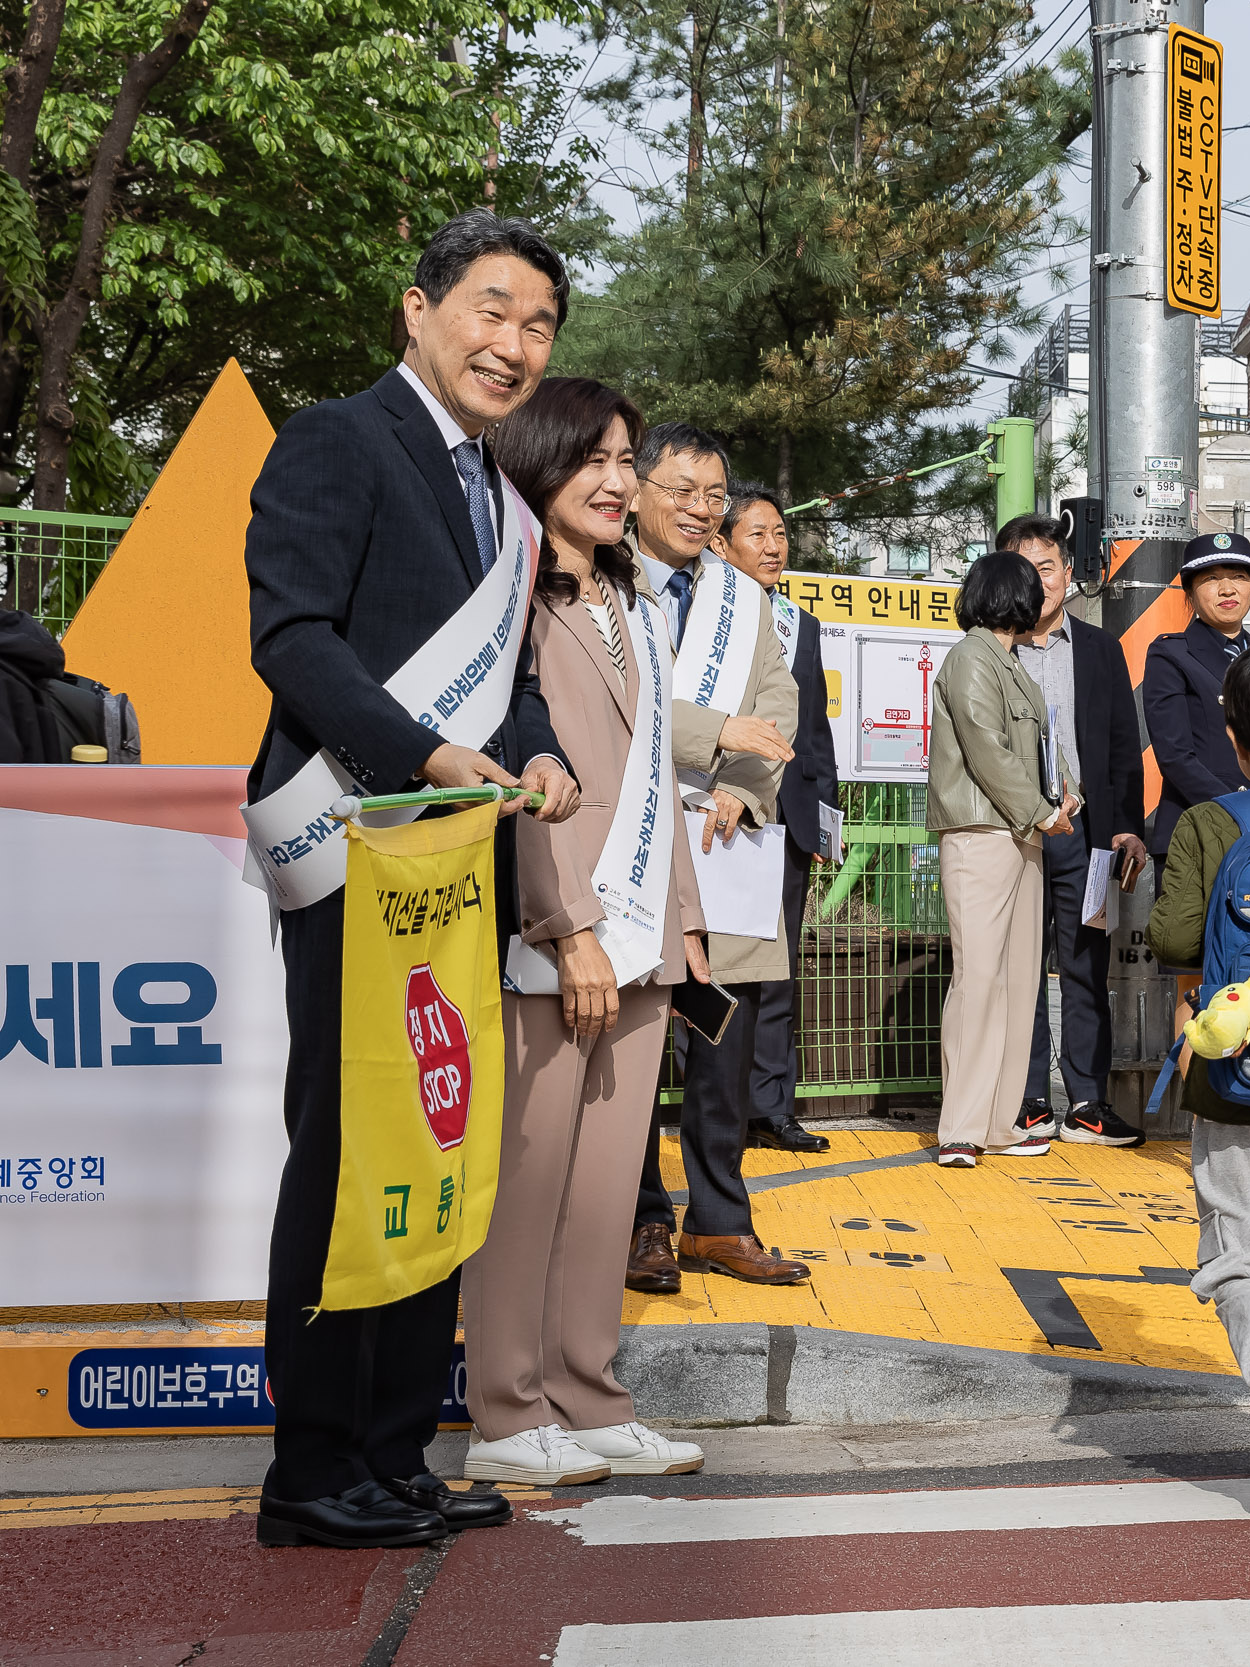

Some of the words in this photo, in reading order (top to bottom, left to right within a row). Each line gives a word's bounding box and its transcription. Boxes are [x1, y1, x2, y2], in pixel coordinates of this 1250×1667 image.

[1176, 86, 1194, 160] 불법
[1157, 481, 1175, 492] 598
[1163, 460, 1178, 469] 보안등
[868, 587, 951, 623] 안내문
[708, 604, 734, 665] 안전하게
[432, 641, 499, 721] 등하굣길
[886, 710, 909, 720] 금연거리
[650, 709, 663, 787] 안전하게
[629, 787, 658, 888] 지켜주세요
[1118, 948, 1139, 964] 16
[423, 1063, 462, 1115] STOP
[30, 1190, 105, 1203] Federation
[79, 1362, 260, 1410] 어린이보호구역
